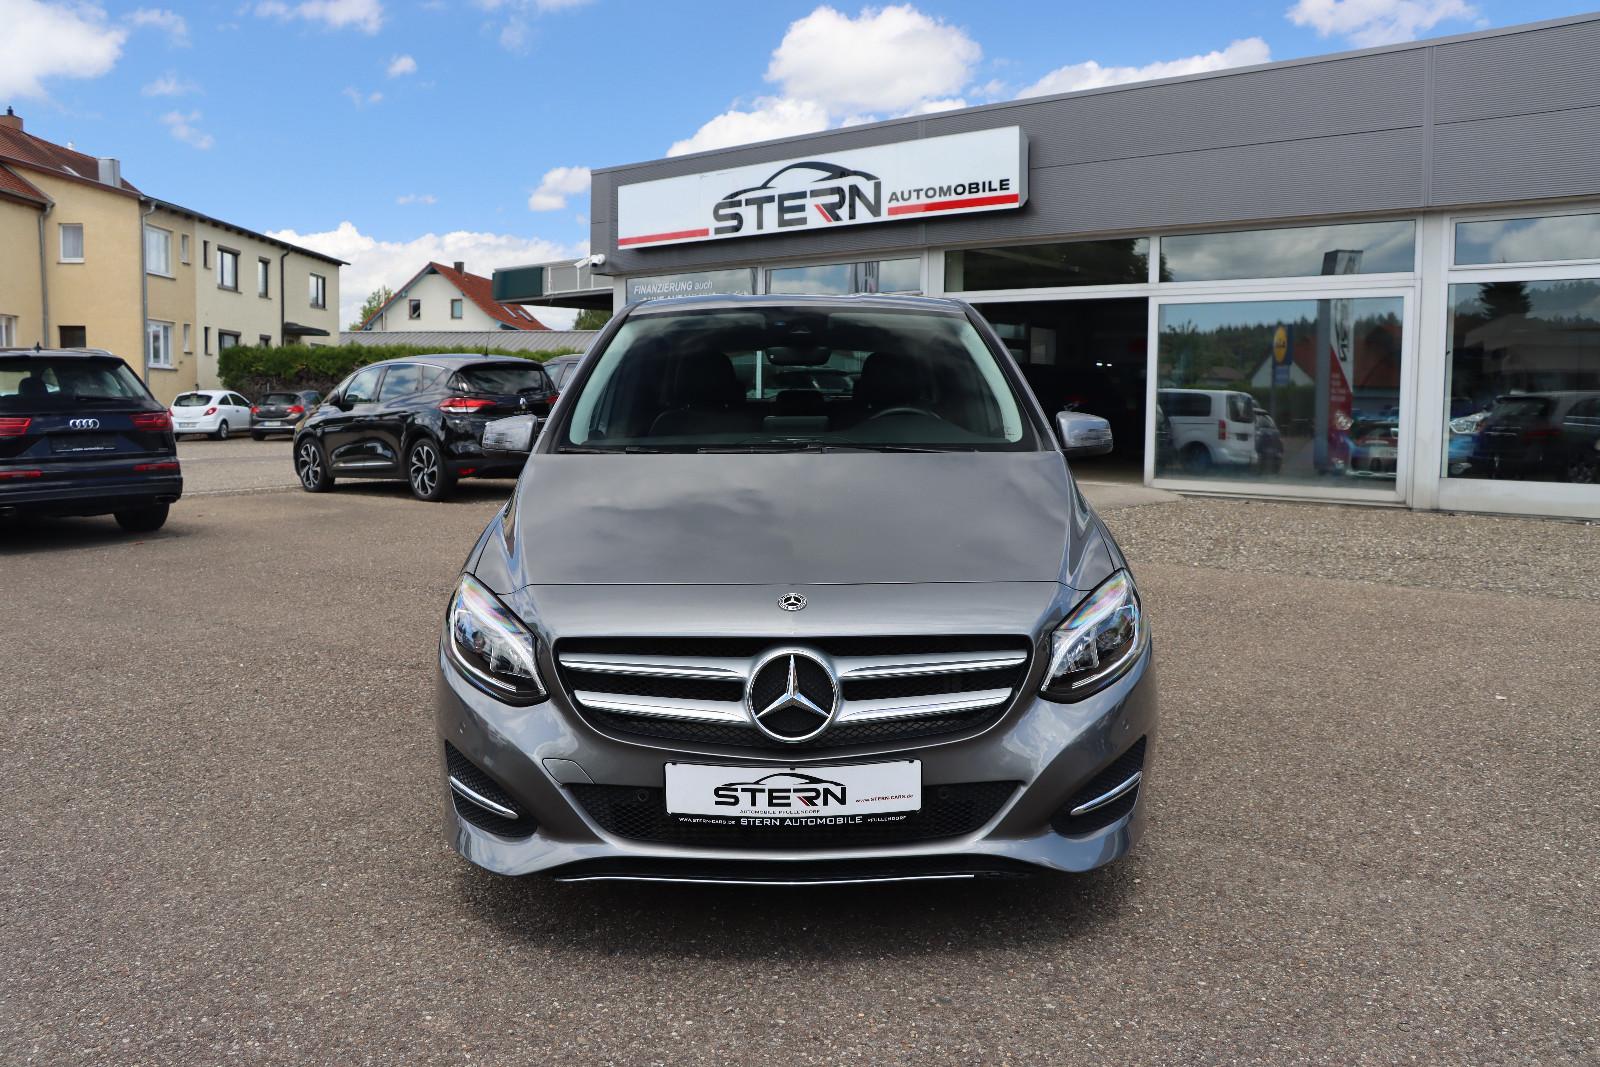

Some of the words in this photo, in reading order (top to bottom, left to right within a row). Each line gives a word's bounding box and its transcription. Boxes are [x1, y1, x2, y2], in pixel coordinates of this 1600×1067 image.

[712, 179, 882, 236] STERN
[888, 178, 1011, 204] AUTOMOBILE
[633, 281, 693, 295] FINANZIERUNG
[694, 279, 713, 290] auch
[713, 786, 847, 807] STERN
[740, 818, 780, 826] STERN
[784, 815, 863, 827] AUTOMOBILE
